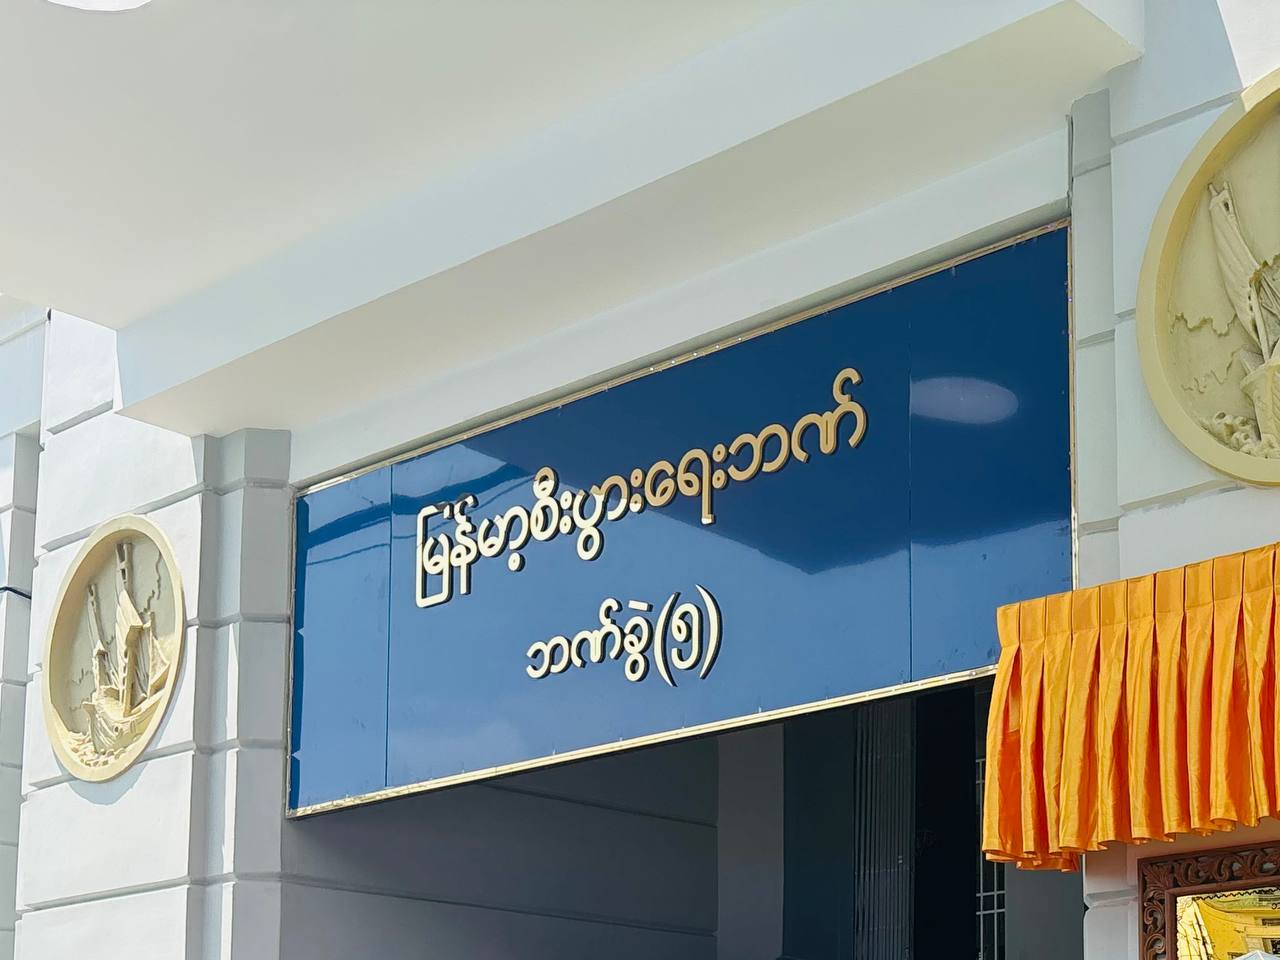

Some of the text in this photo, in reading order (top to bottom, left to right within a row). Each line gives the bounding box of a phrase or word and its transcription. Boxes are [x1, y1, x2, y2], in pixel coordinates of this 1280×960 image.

[416, 367, 867, 608] မြန်မာ့စီးပွားရေးဘဏ်
[526, 583, 723, 687] ဘဏ်ခွဲ(၅)
